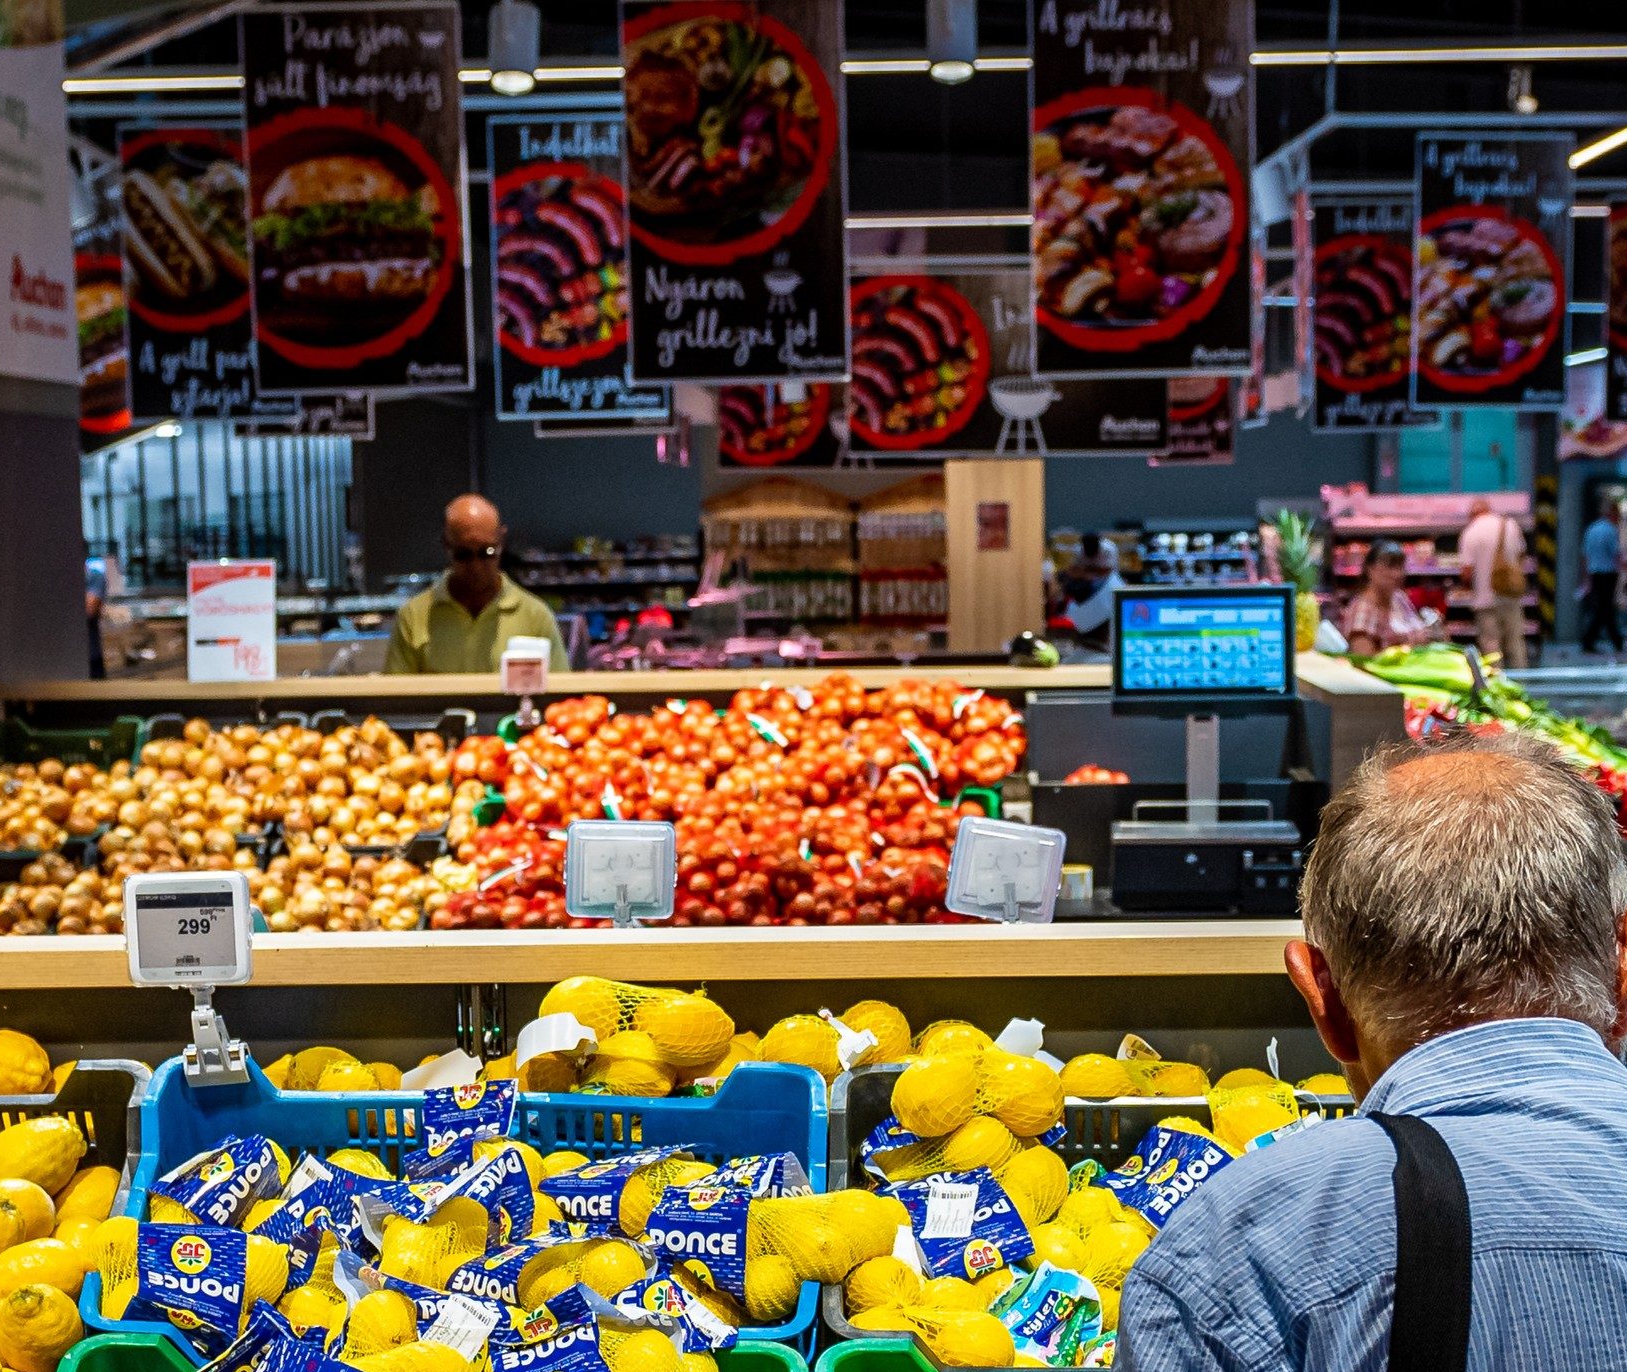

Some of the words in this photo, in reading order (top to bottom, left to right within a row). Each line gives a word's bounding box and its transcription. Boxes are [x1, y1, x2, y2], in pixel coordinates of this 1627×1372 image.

[177, 918, 211, 935] 299
[208, 1147, 273, 1225] PONCE
[1148, 1145, 1224, 1216] PONCE
[649, 1228, 738, 1256] PONCE
[148, 1271, 241, 1304] PONCE
[451, 1269, 518, 1305] PONCE
[1022, 1294, 1056, 1336] tyler
[502, 1326, 595, 1371] PONCE
